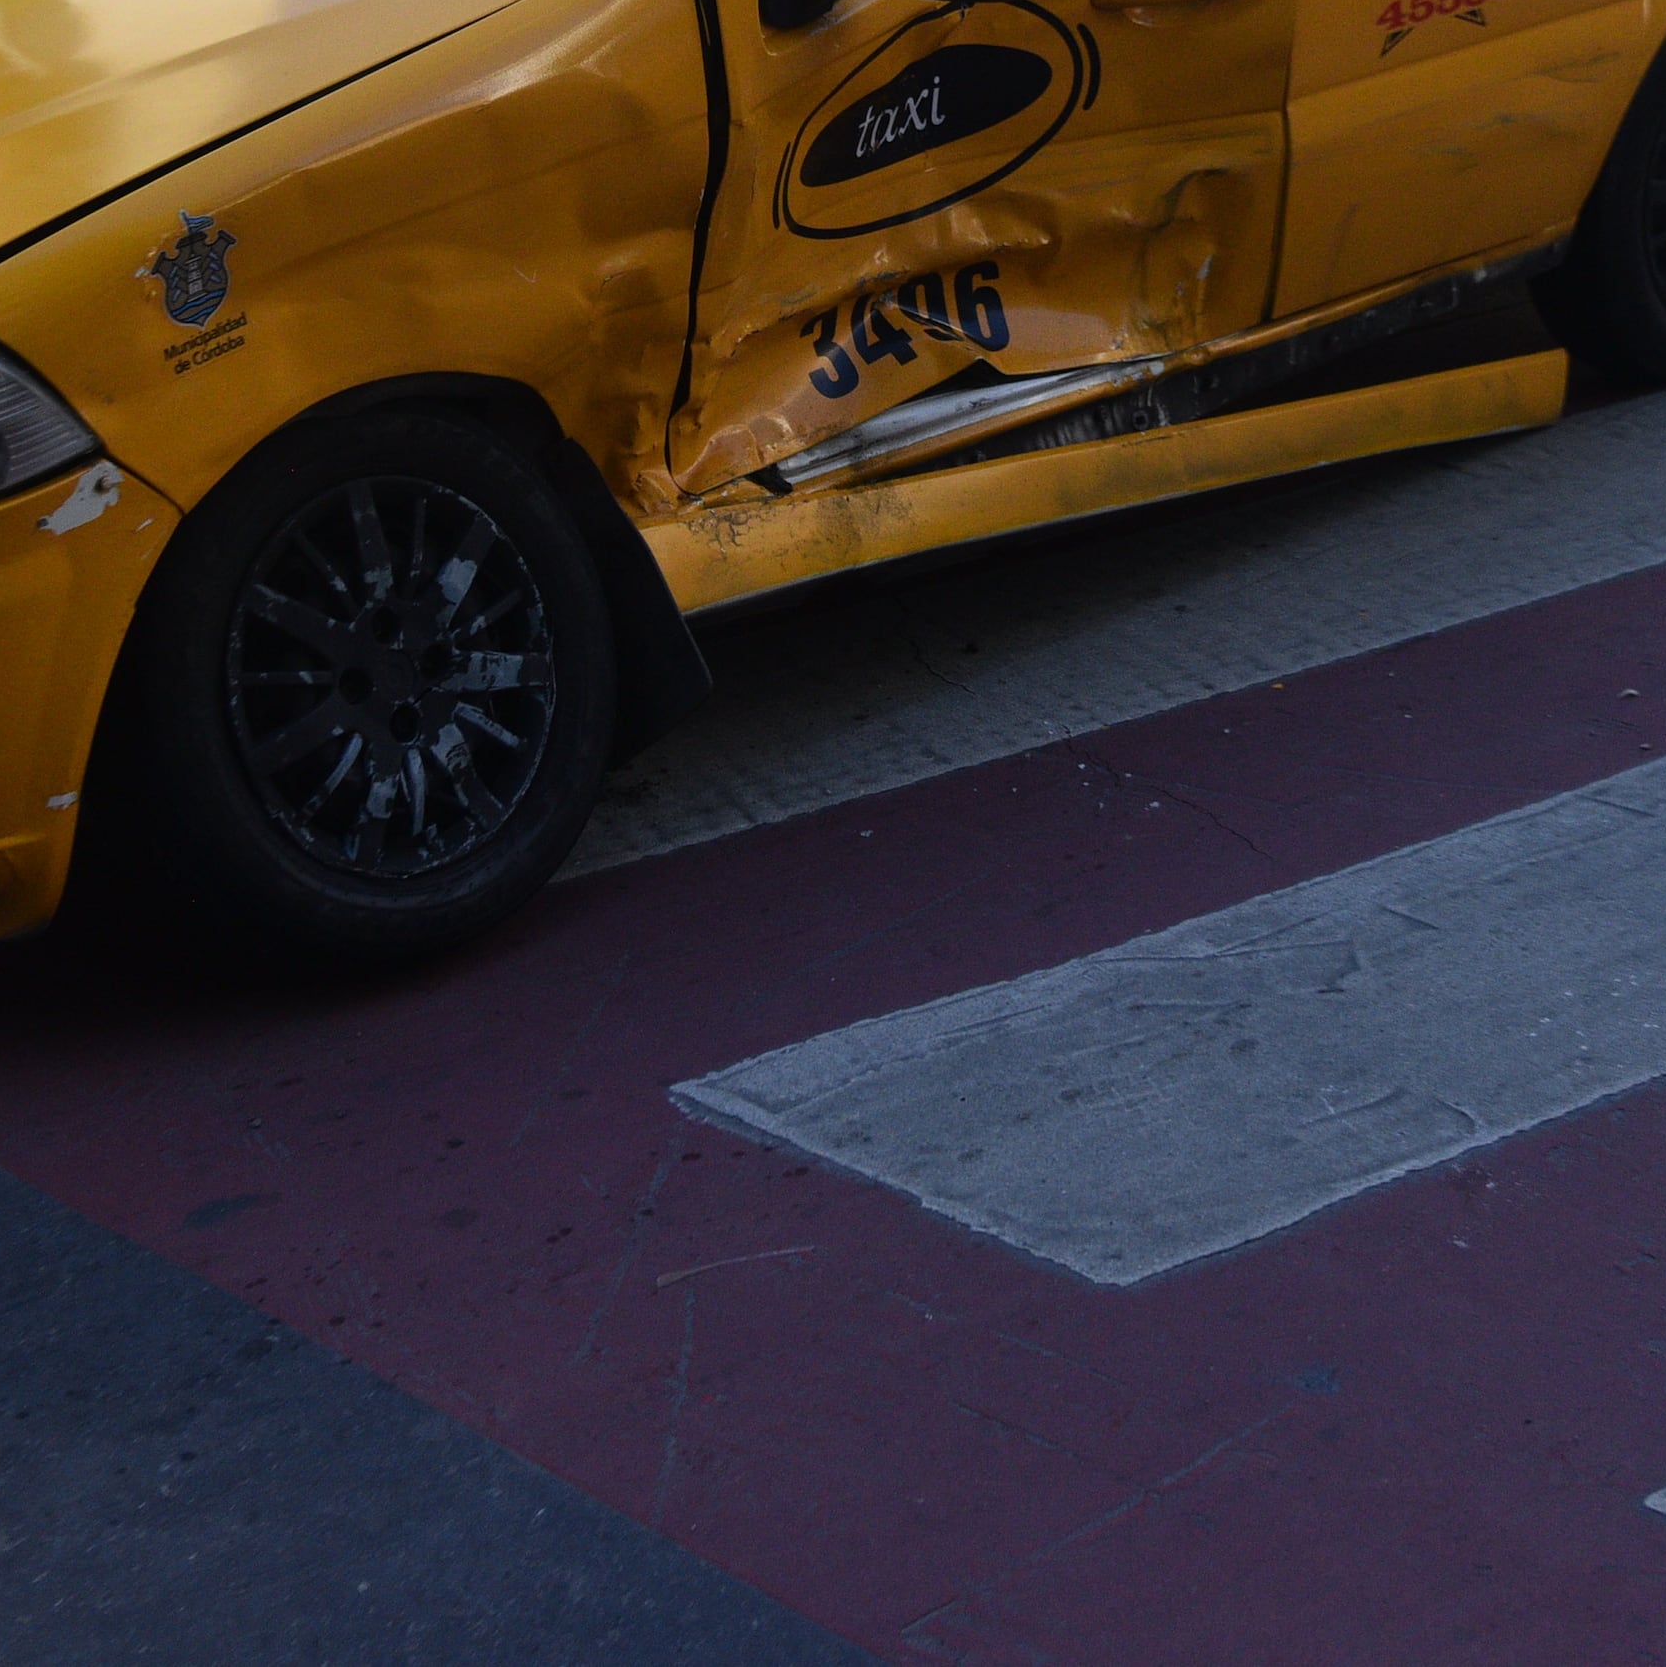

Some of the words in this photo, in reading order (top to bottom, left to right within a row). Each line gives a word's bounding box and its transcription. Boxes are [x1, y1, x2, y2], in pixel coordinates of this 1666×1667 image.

[854, 75, 946, 159] taxi
[163, 311, 248, 362] Municipalidad
[174, 361, 191, 375] de
